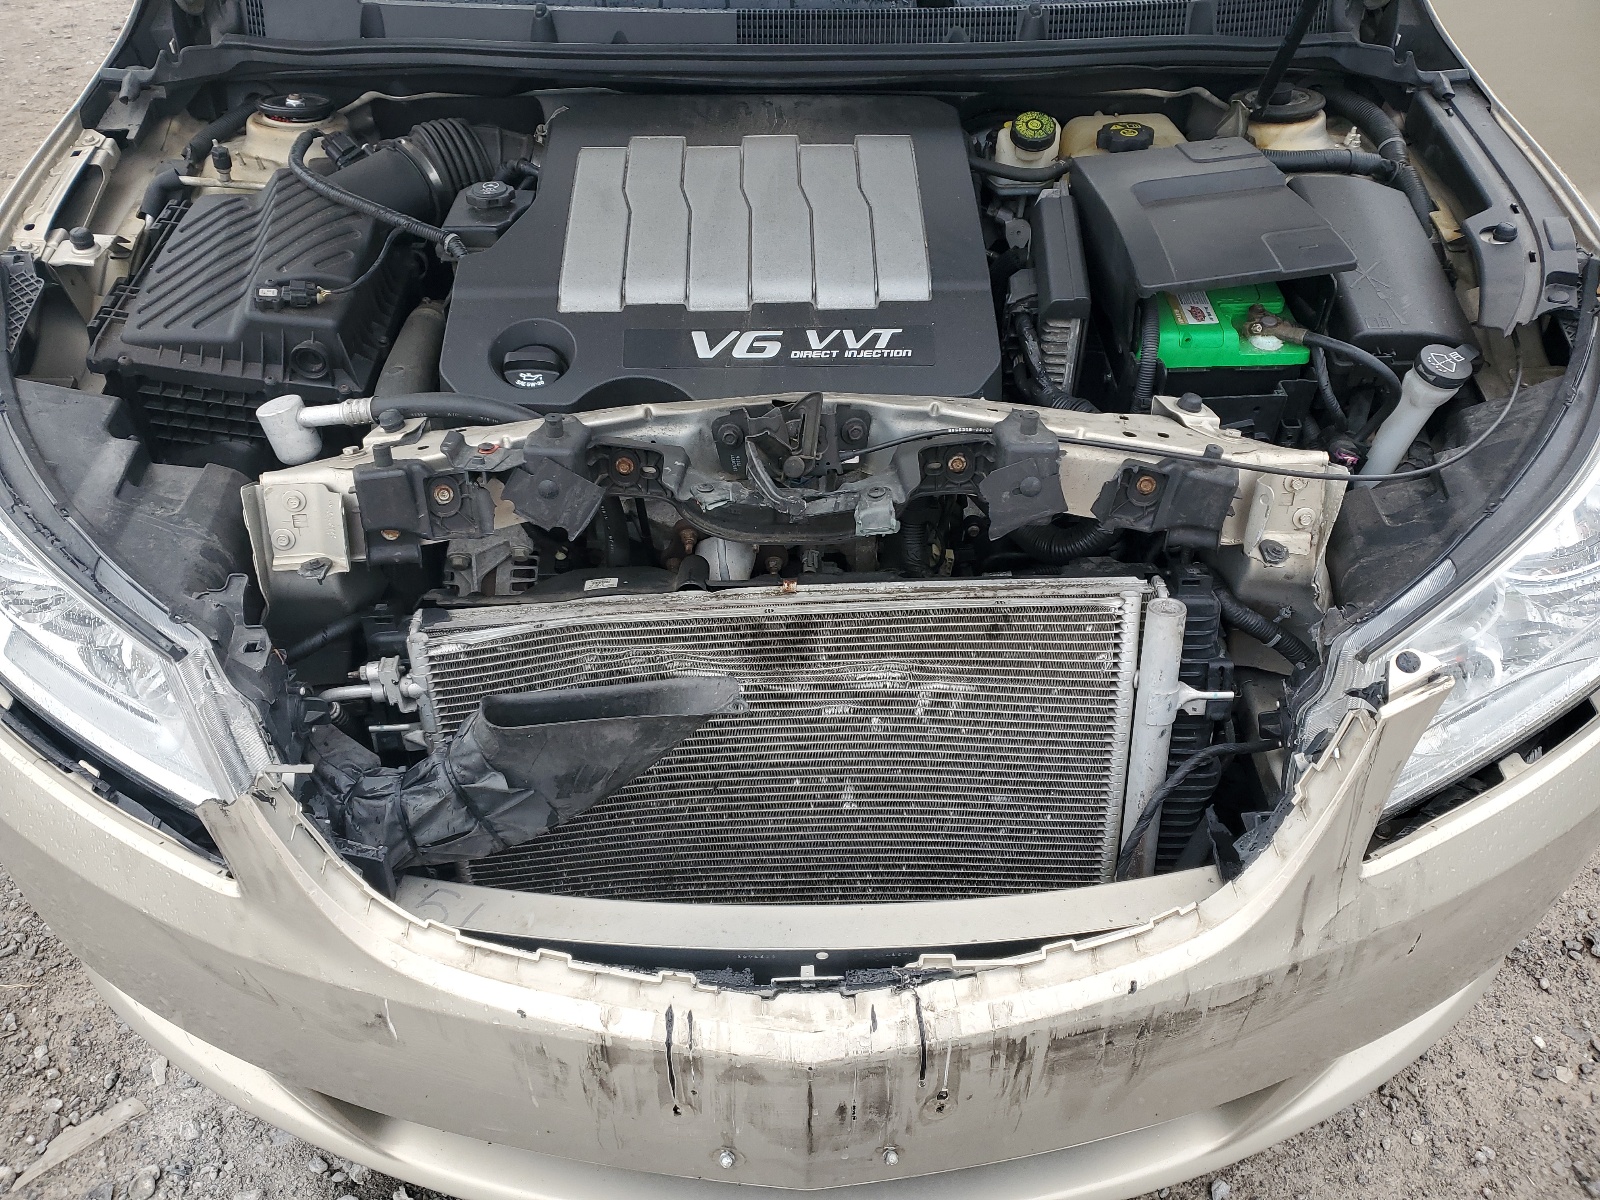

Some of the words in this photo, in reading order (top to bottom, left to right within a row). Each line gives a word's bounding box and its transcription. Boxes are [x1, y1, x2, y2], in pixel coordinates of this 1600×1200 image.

[691, 330, 784, 359] V6
[805, 328, 903, 350] VVT
[790, 349, 840, 359] DIRECT
[844, 348, 913, 359] INJECTION
